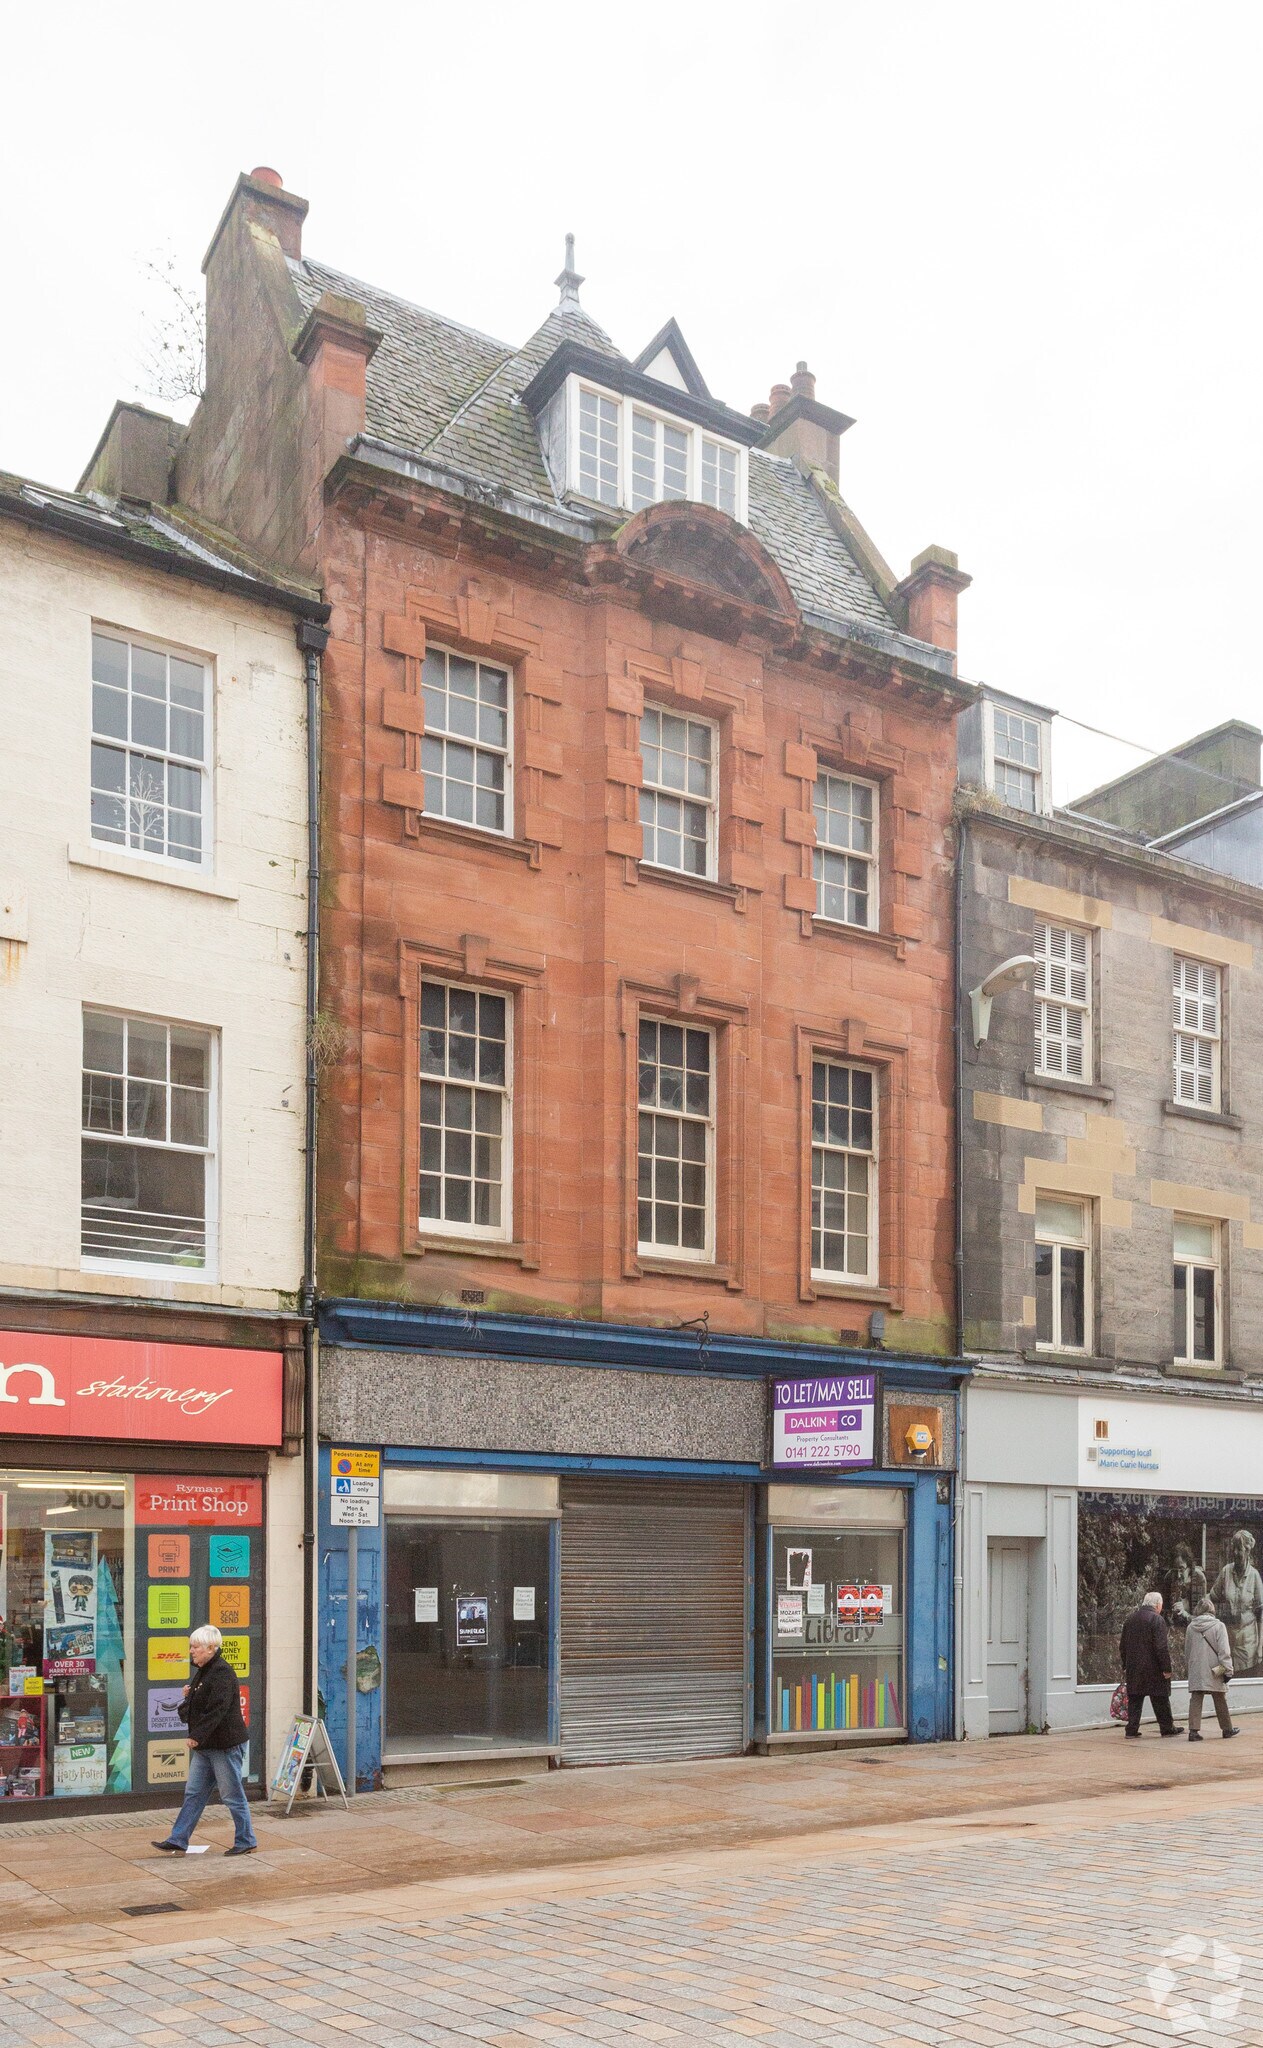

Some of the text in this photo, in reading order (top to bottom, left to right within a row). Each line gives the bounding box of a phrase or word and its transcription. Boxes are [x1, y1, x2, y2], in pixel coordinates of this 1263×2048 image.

[76, 1375, 233, 1415] stationery
[776, 1379, 872, 1404] TO LET/MAY SELL
[790, 1416, 827, 1429] DALKIN
[841, 1415, 857, 1426] CO
[796, 1434, 849, 1443] Property Consultants
[785, 1444, 861, 1458] 0141 222 5790
[1099, 1446, 1152, 1458] Supporting local
[1100, 1459, 1159, 1470] Marie Curie Nurses
[175, 1484, 224, 1494] Ryman
[150, 1495, 249, 1516] Print Shop
[158, 1565, 180, 1573] PRINT
[804, 1619, 875, 1644] Library
[54, 1660, 74, 1668] OVER
[71, 1747, 91, 1757] NEW
[57, 1767, 104, 1783] Harry Potter
[152, 1771, 185, 1779] LAMINATE
